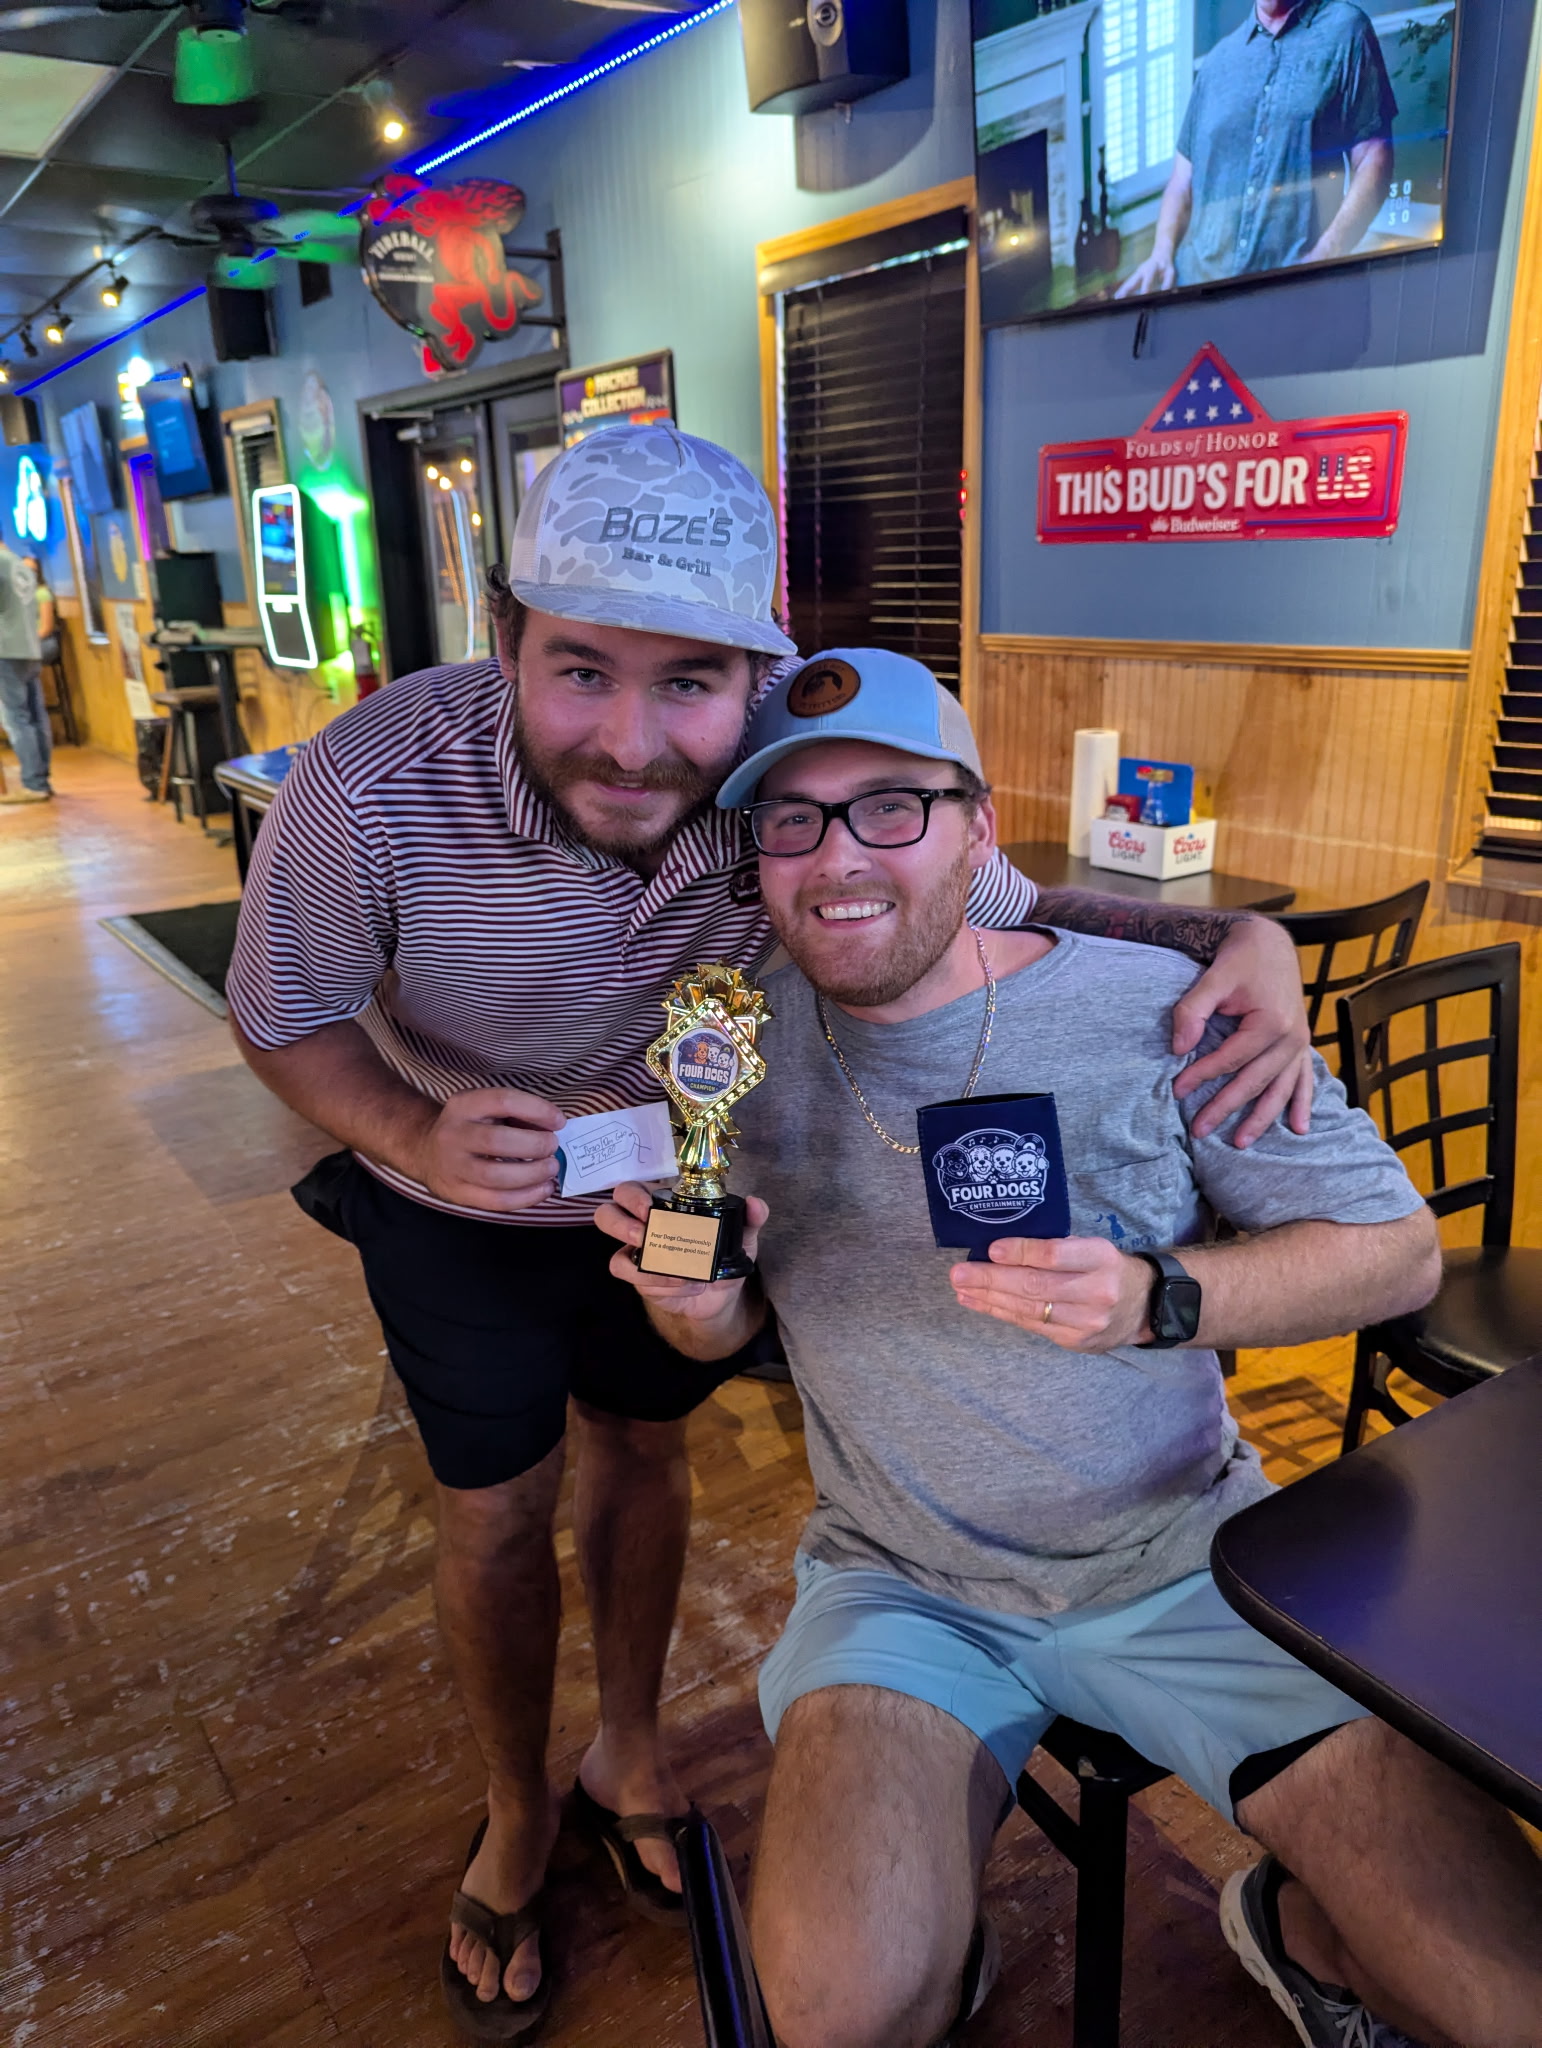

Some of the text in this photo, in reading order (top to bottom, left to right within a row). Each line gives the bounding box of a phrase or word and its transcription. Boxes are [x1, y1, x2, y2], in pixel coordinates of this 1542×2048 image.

[1126, 431, 1279, 459] FOLDS of HONOR
[1056, 454, 1374, 516] THIS BUD'S FOR US
[599, 506, 733, 547] BOZE'S
[1169, 515, 1241, 533] Budweiser
[622, 547, 712, 577] Bar & Grill
[1108, 831, 1146, 854] Coors
[1173, 836, 1207, 855] Coors
[679, 1063, 730, 1084] FOUR DOGS
[951, 1180, 1041, 1203] FOUR DOGS
[969, 1200, 1026, 1211] ENTERTAINMENT
[650, 1231, 663, 1239] Four
[663, 1233, 676, 1241] Dogs
